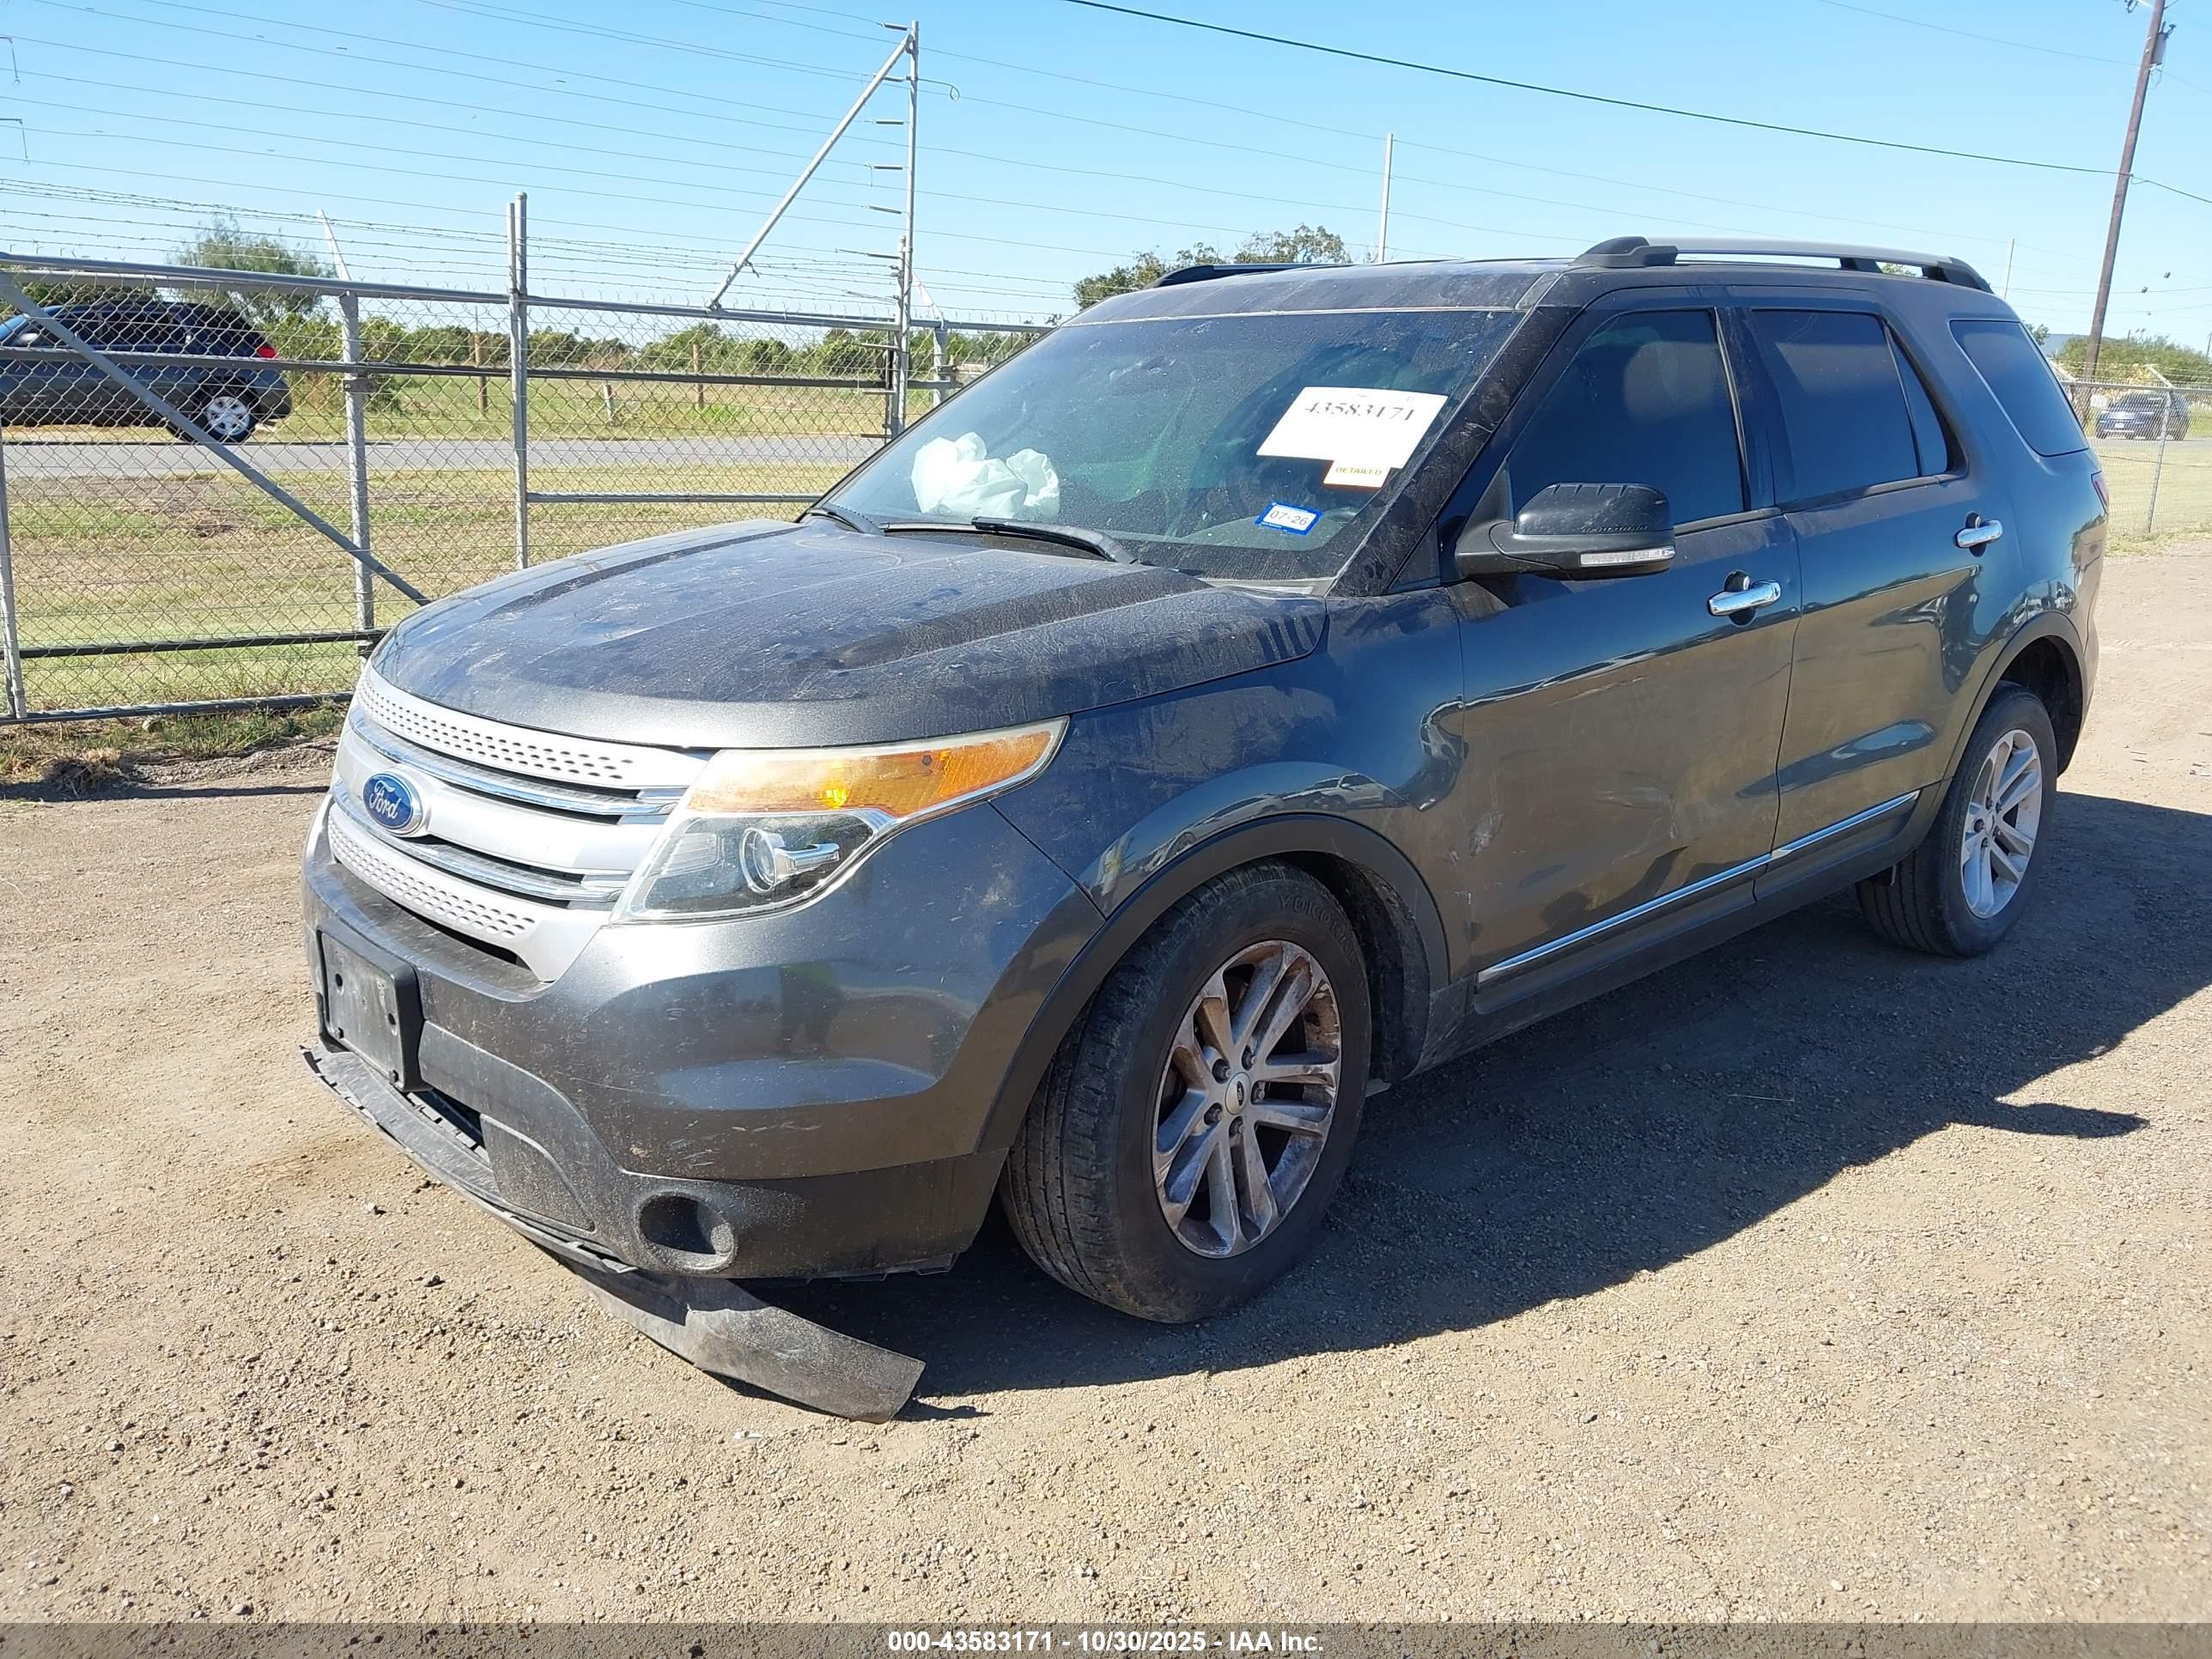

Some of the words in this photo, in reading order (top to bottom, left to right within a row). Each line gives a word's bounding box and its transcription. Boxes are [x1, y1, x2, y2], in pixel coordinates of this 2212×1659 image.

[1304, 401, 1415, 421] 43583171
[1335, 466, 1382, 476] DETAILED
[369, 780, 402, 819] Ford
